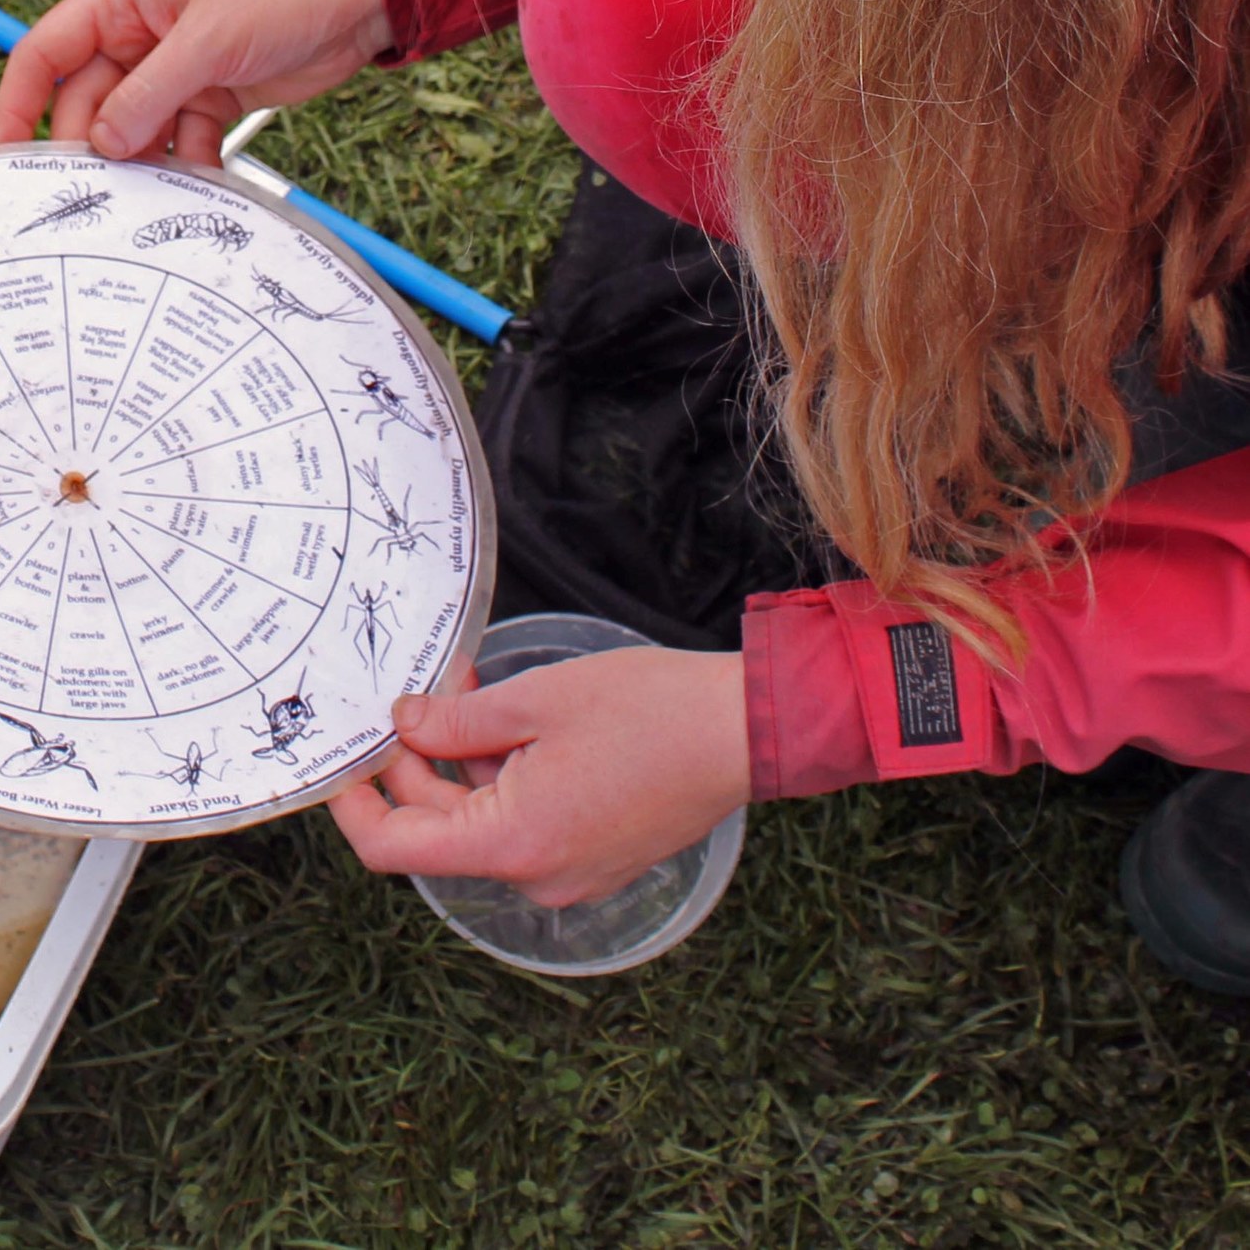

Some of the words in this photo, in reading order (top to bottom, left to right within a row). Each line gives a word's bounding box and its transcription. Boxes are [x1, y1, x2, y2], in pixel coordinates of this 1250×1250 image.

[8, 158, 66, 171] Alderfly
[70, 159, 105, 170] larva
[156, 171, 216, 200] Caddisfly
[218, 193, 248, 211] larva
[294, 233, 335, 270] Mayfly
[334, 269, 374, 305] nymph
[391, 329, 429, 390] Dragonfly
[423, 392, 452, 438] nymph
[292, 437, 305, 463] black
[308, 445, 322, 480] beetles
[185, 458, 199, 493] surface
[238, 463, 252, 490] spins
[249, 451, 262, 485] surface
[299, 465, 311, 491] shiny
[448, 457, 468, 523] Damselfly
[168, 501, 183, 532] plants
[183, 502, 197, 527] open
[195, 510, 207, 535] water
[227, 526, 243, 544] fast
[238, 514, 257, 562] swimmers
[299, 521, 312, 547] small
[160, 547, 185, 574] plants
[302, 551, 318, 580] beetle
[311, 524, 326, 550] types
[448, 525, 466, 572] nymph
[23, 558, 58, 575] plants
[292, 548, 308, 576] many
[14, 575, 51, 596] bottom
[68, 571, 101, 582] plants
[66, 594, 106, 603] bottom
[192, 574, 227, 611] swimmer
[210, 581, 238, 611] crawler
[138, 622, 184, 644] swimmer
[141, 615, 167, 631] jerky
[231, 631, 254, 652] large
[250, 596, 287, 633] snapping
[259, 623, 280, 644] jaws
[429, 602, 458, 640] Water
[69, 630, 105, 639] crawls
[183, 662, 198, 672] no
[198, 653, 219, 669] gills
[411, 640, 437, 674] Stick
[60, 665, 86, 678] long
[87, 666, 111, 678] gills
[113, 678, 134, 687] will
[164, 681, 179, 690] on
[179, 666, 225, 686] abdomen
[69, 698, 98, 709] large
[100, 700, 126, 709] jaws
[102, 689, 127, 697] with
[344, 726, 382, 749] Water
[292, 745, 348, 779] Scorpion
[21, 794, 58, 810] Water
[62, 802, 101, 818] Lesser
[149, 799, 199, 813] Skater
[201, 793, 242, 809] Pond
